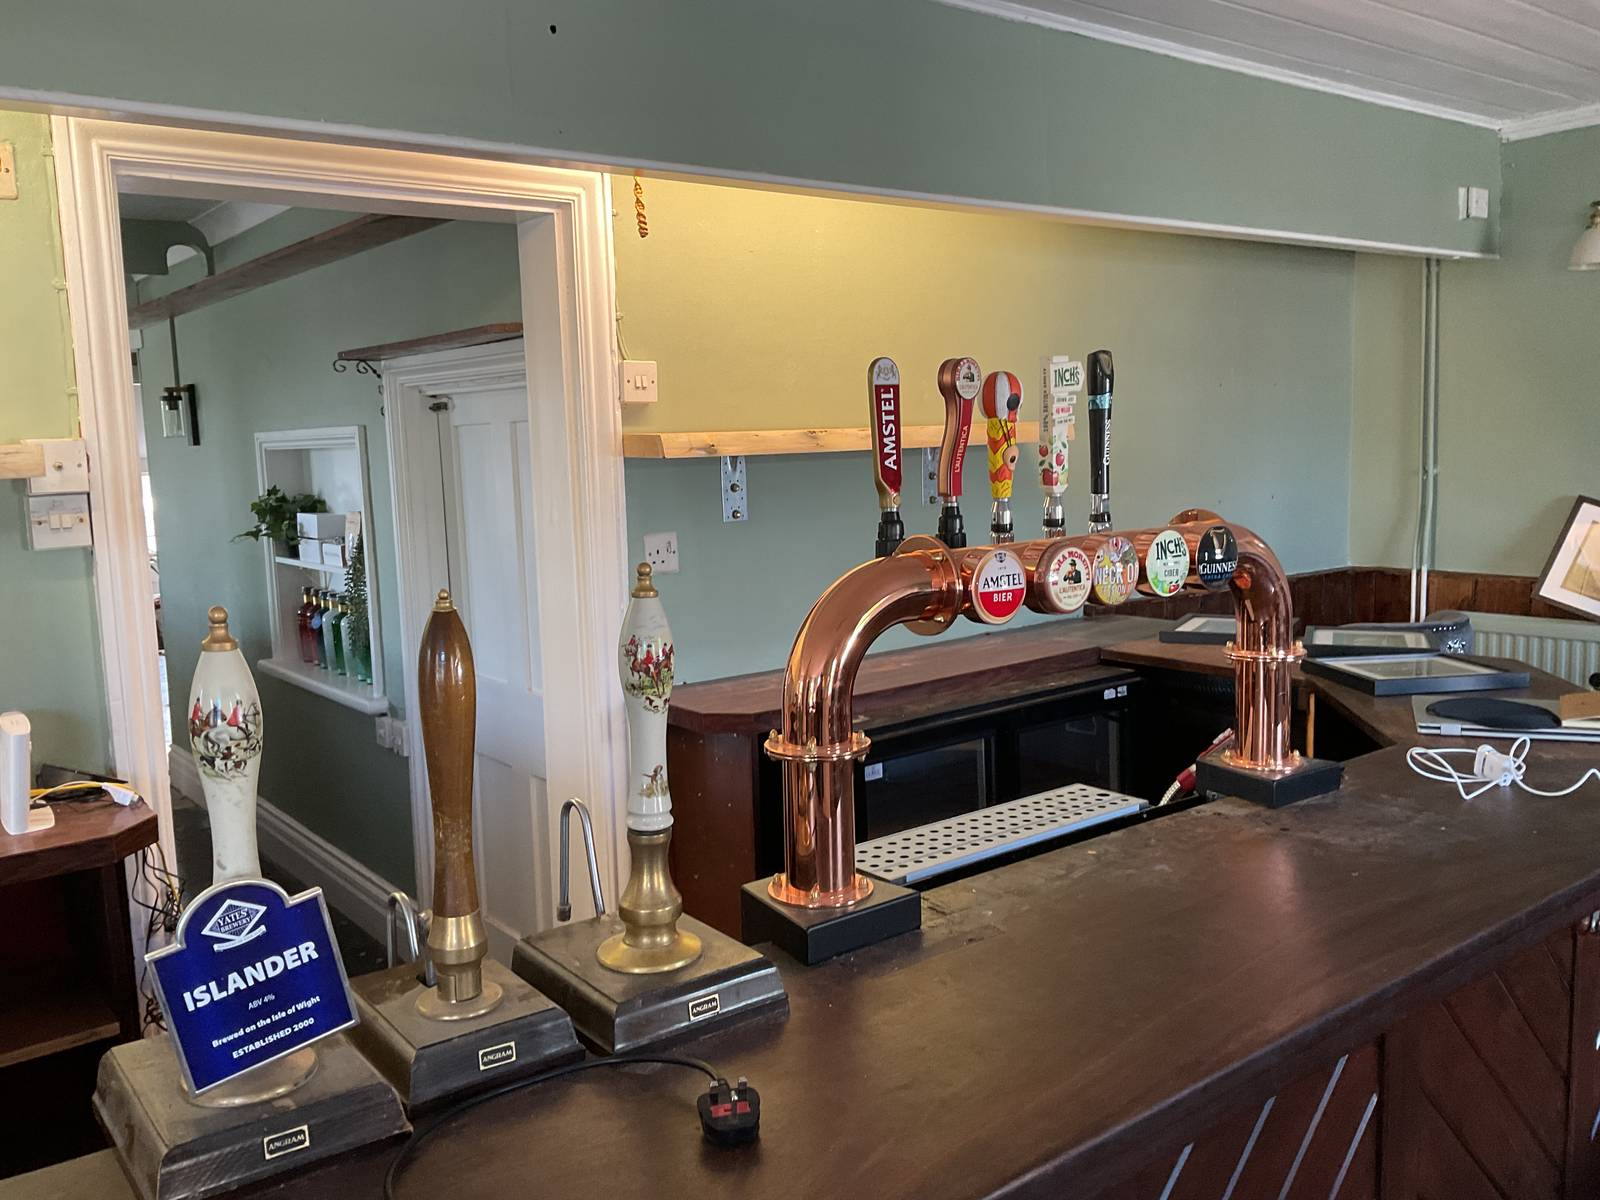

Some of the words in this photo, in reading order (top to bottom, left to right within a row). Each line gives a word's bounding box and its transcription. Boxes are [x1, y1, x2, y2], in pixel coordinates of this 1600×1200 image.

[881, 388, 897, 471] AMSTEL
[983, 573, 1023, 589] AMSTEL
[1095, 565, 1124, 586] NECK
[1164, 568, 1179, 577] CIDER
[993, 592, 1012, 602] BIER
[183, 941, 319, 1012] ISLANDER
[248, 998, 262, 1010] ABV
[263, 993, 275, 1003] 4%
[212, 1028, 244, 1048] Brewed
[245, 1024, 256, 1033] on
[256, 1017, 271, 1028] the
[271, 1011, 286, 1022] Isle
[287, 1005, 295, 1015] of
[296, 995, 320, 1011] Wight
[232, 1027, 292, 1059] ESTABLISHED
[292, 1017, 315, 1032] 2000
